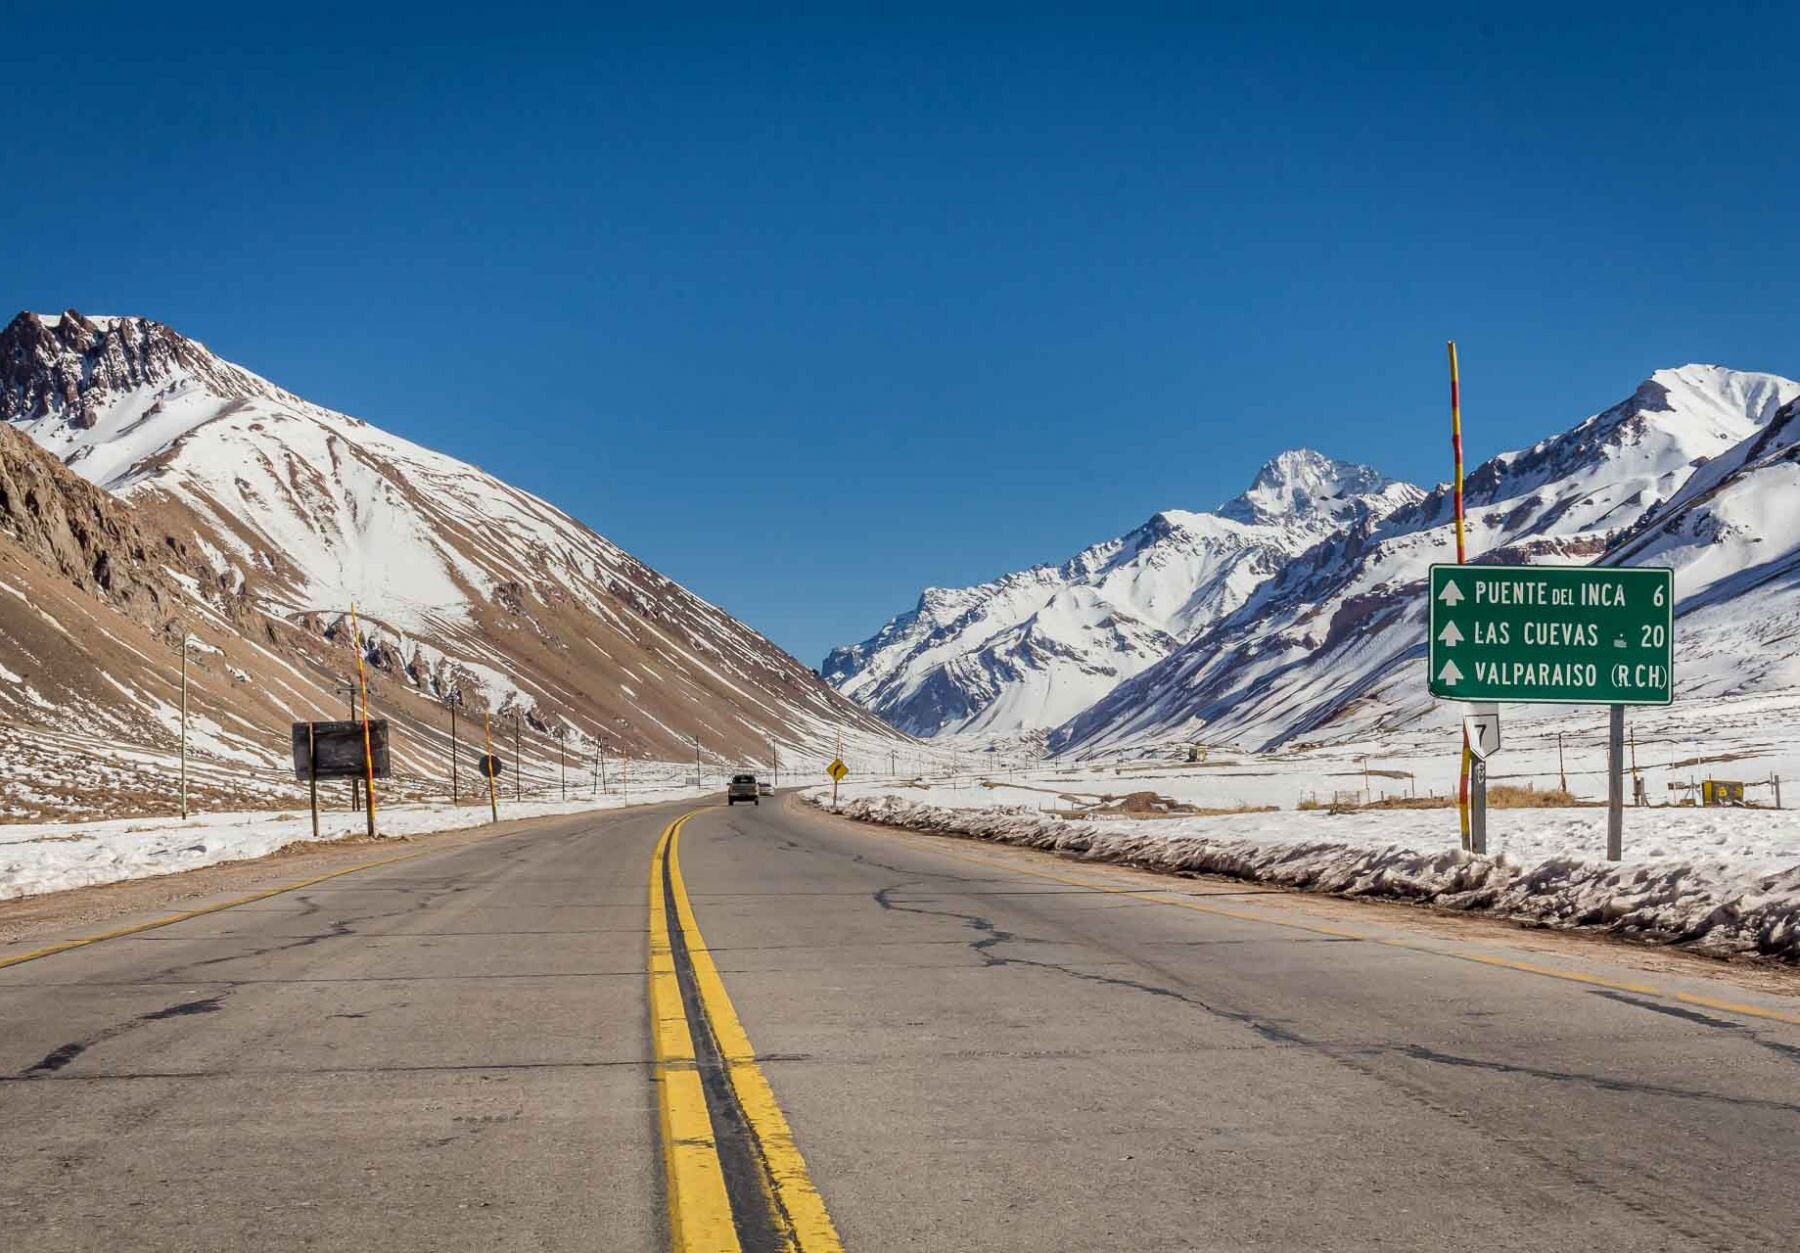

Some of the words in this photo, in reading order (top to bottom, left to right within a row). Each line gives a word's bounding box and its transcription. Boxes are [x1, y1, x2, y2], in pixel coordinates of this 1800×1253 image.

[1475, 580, 1548, 605] PUENTE
[1552, 588, 1575, 606] DEL
[1581, 583, 1627, 607] INCA
[1653, 584, 1665, 608] 6
[1474, 621, 1511, 646] LAS
[1523, 621, 1599, 647] CUEVAS
[1641, 624, 1666, 649] 20
[1475, 662, 1597, 687] VALPARAISO
[1474, 724, 1488, 749] 7
